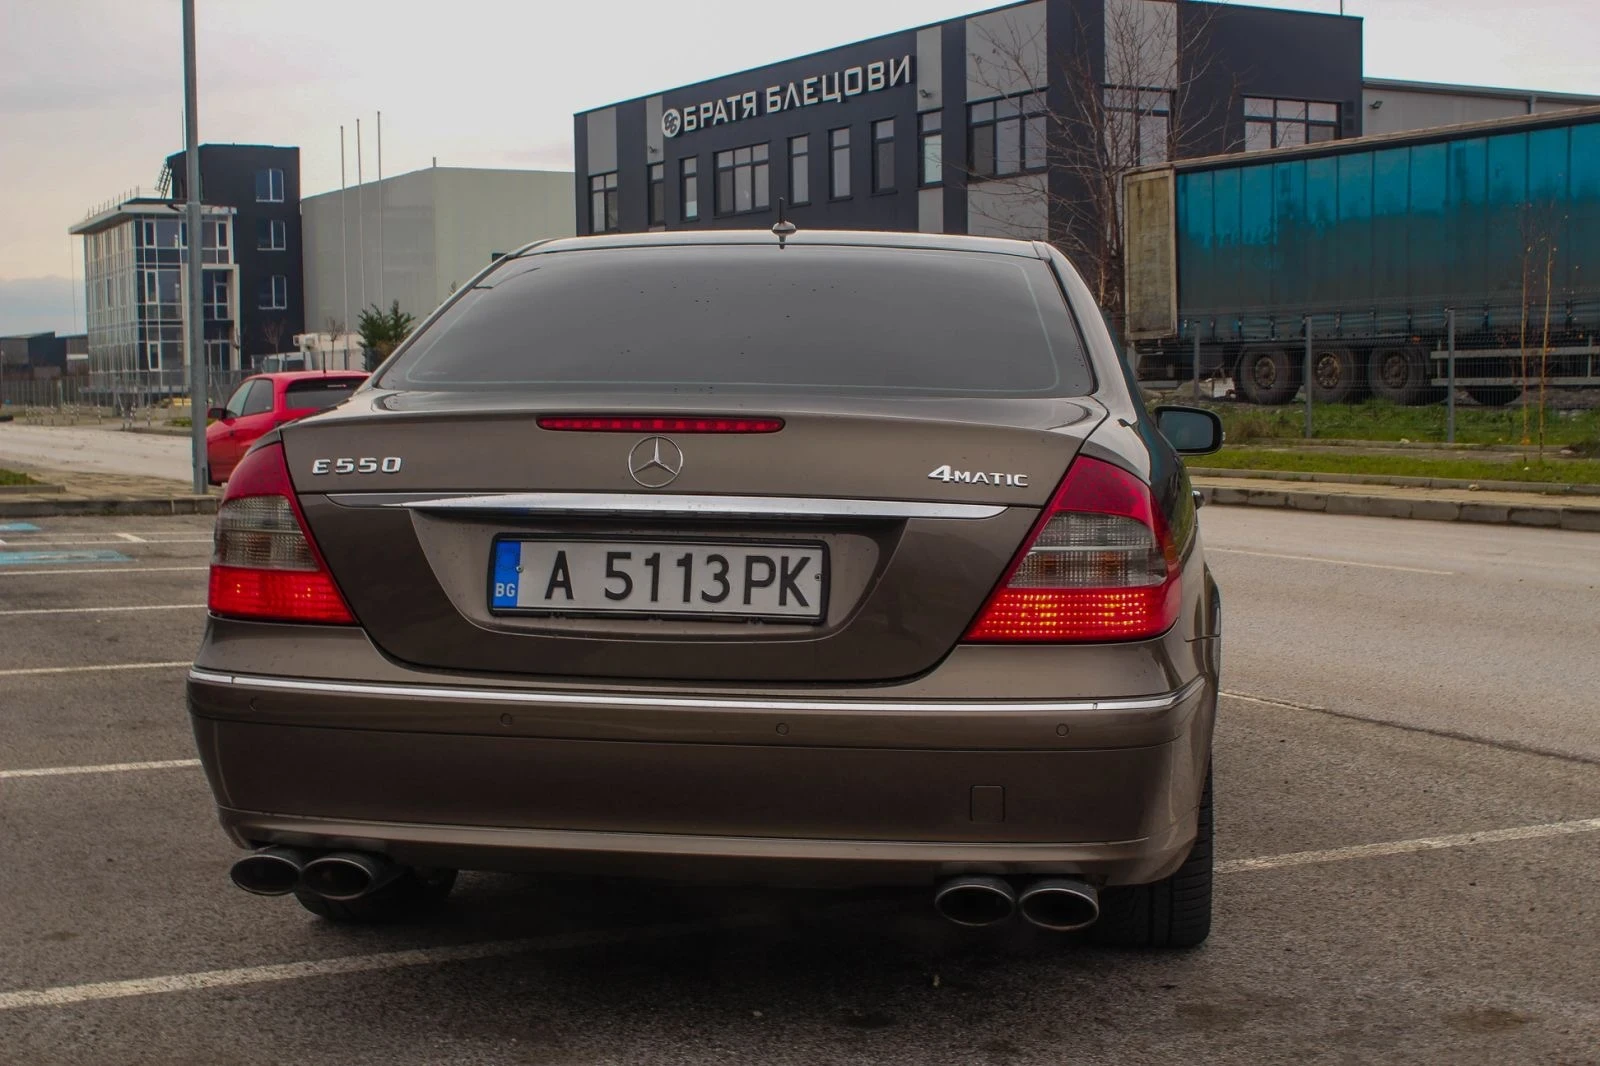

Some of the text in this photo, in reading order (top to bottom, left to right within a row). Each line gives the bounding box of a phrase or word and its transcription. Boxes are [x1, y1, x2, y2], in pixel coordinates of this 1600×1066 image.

[684, 91, 757, 132] БРАТЯ
[766, 55, 911, 113] БЛЕЦОВИ
[927, 465, 1029, 487] 4MATIC
[495, 583, 516, 597] BG
